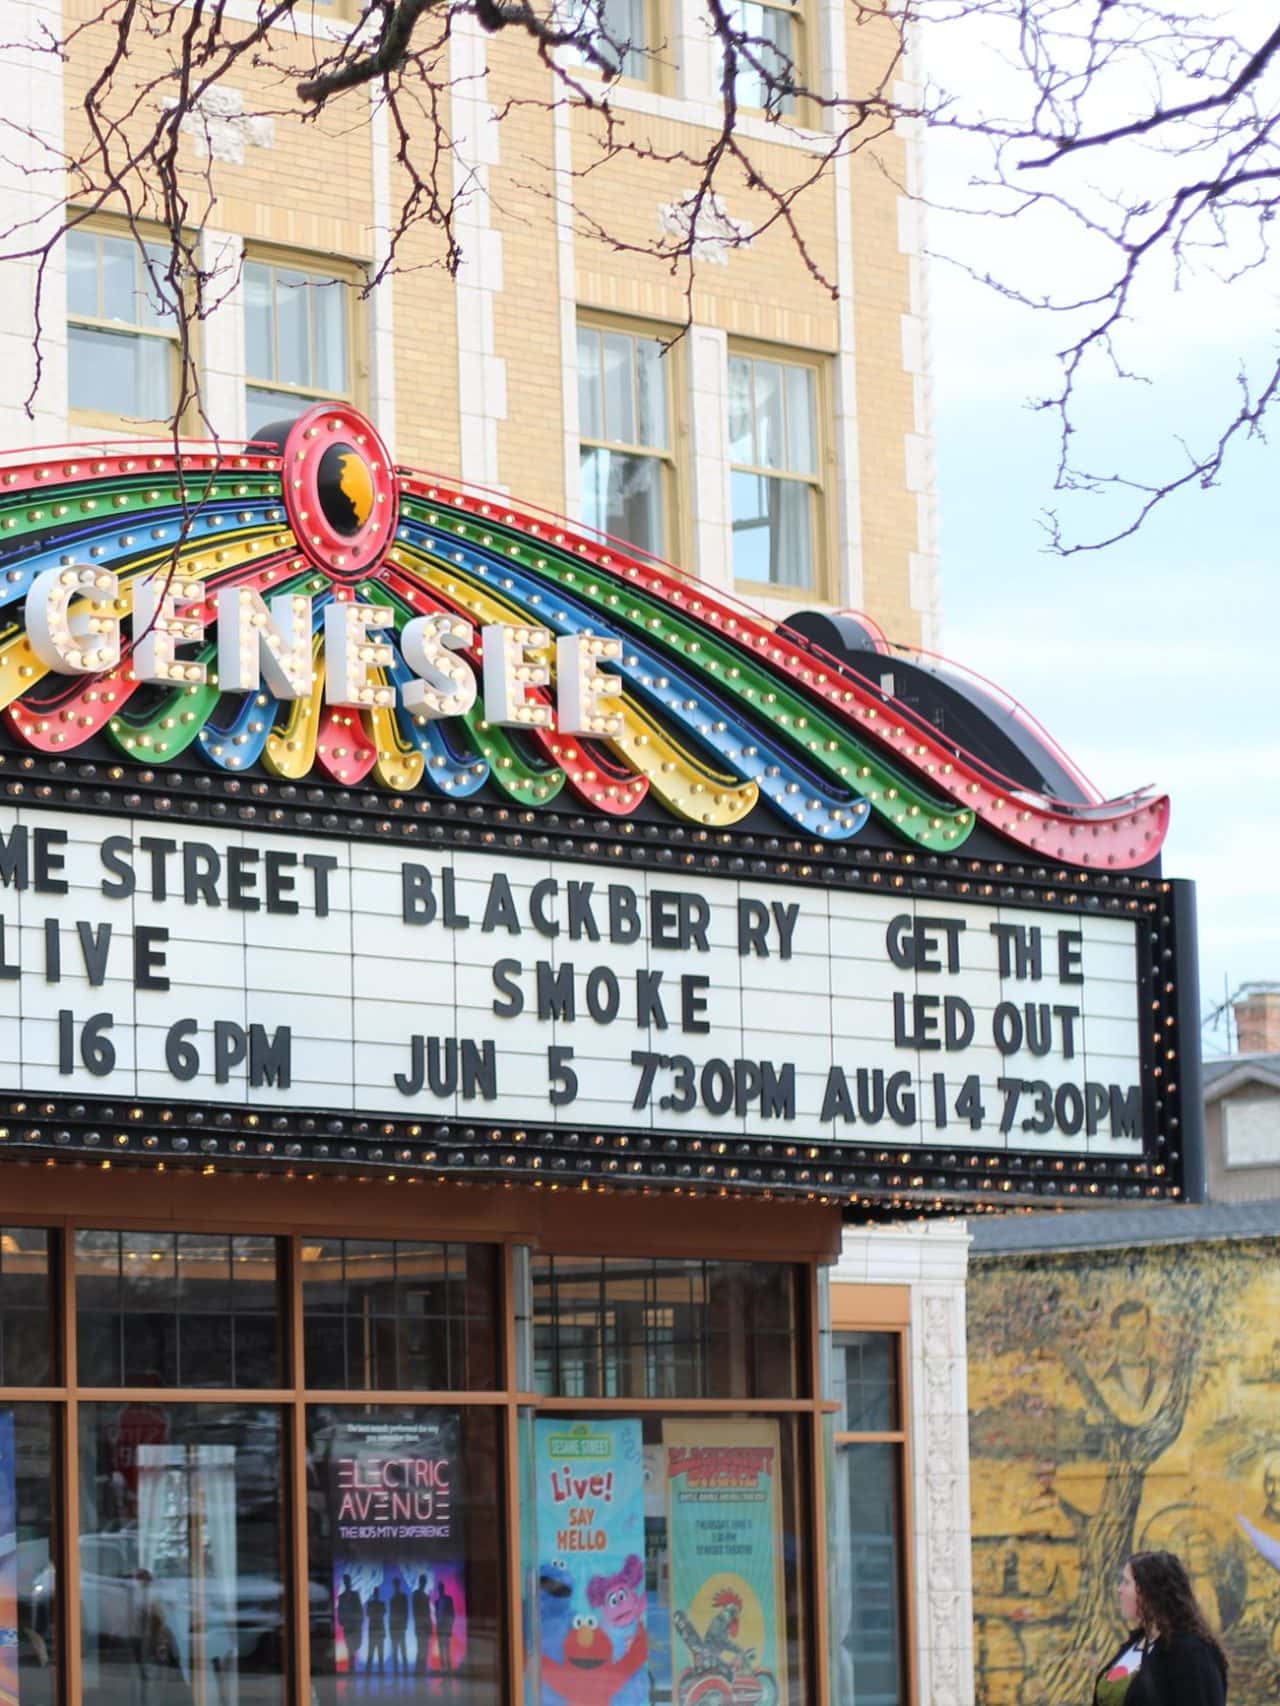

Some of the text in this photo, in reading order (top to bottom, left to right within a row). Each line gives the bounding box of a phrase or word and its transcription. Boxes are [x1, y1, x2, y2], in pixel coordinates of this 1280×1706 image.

[25, 564, 623, 739] GENESEE
[100, 835, 338, 917] STREET
[886, 914, 1084, 986] GET THE
[491, 958, 711, 1035] SMOKE
[893, 991, 1082, 1059] LED OUT
[59, 1009, 116, 1075] 16
[393, 1035, 497, 1101] JUN
[547, 1045, 578, 1106] 5
[820, 1065, 918, 1127] AUG
[933, 1073, 986, 1131] 14
[338, 1459, 449, 1488] ELECTRIC
[338, 1490, 450, 1521] AVENUE
[551, 1465, 613, 1502] Live!
[557, 1529, 607, 1551] HELLO
[569, 1507, 595, 1526] SAY
